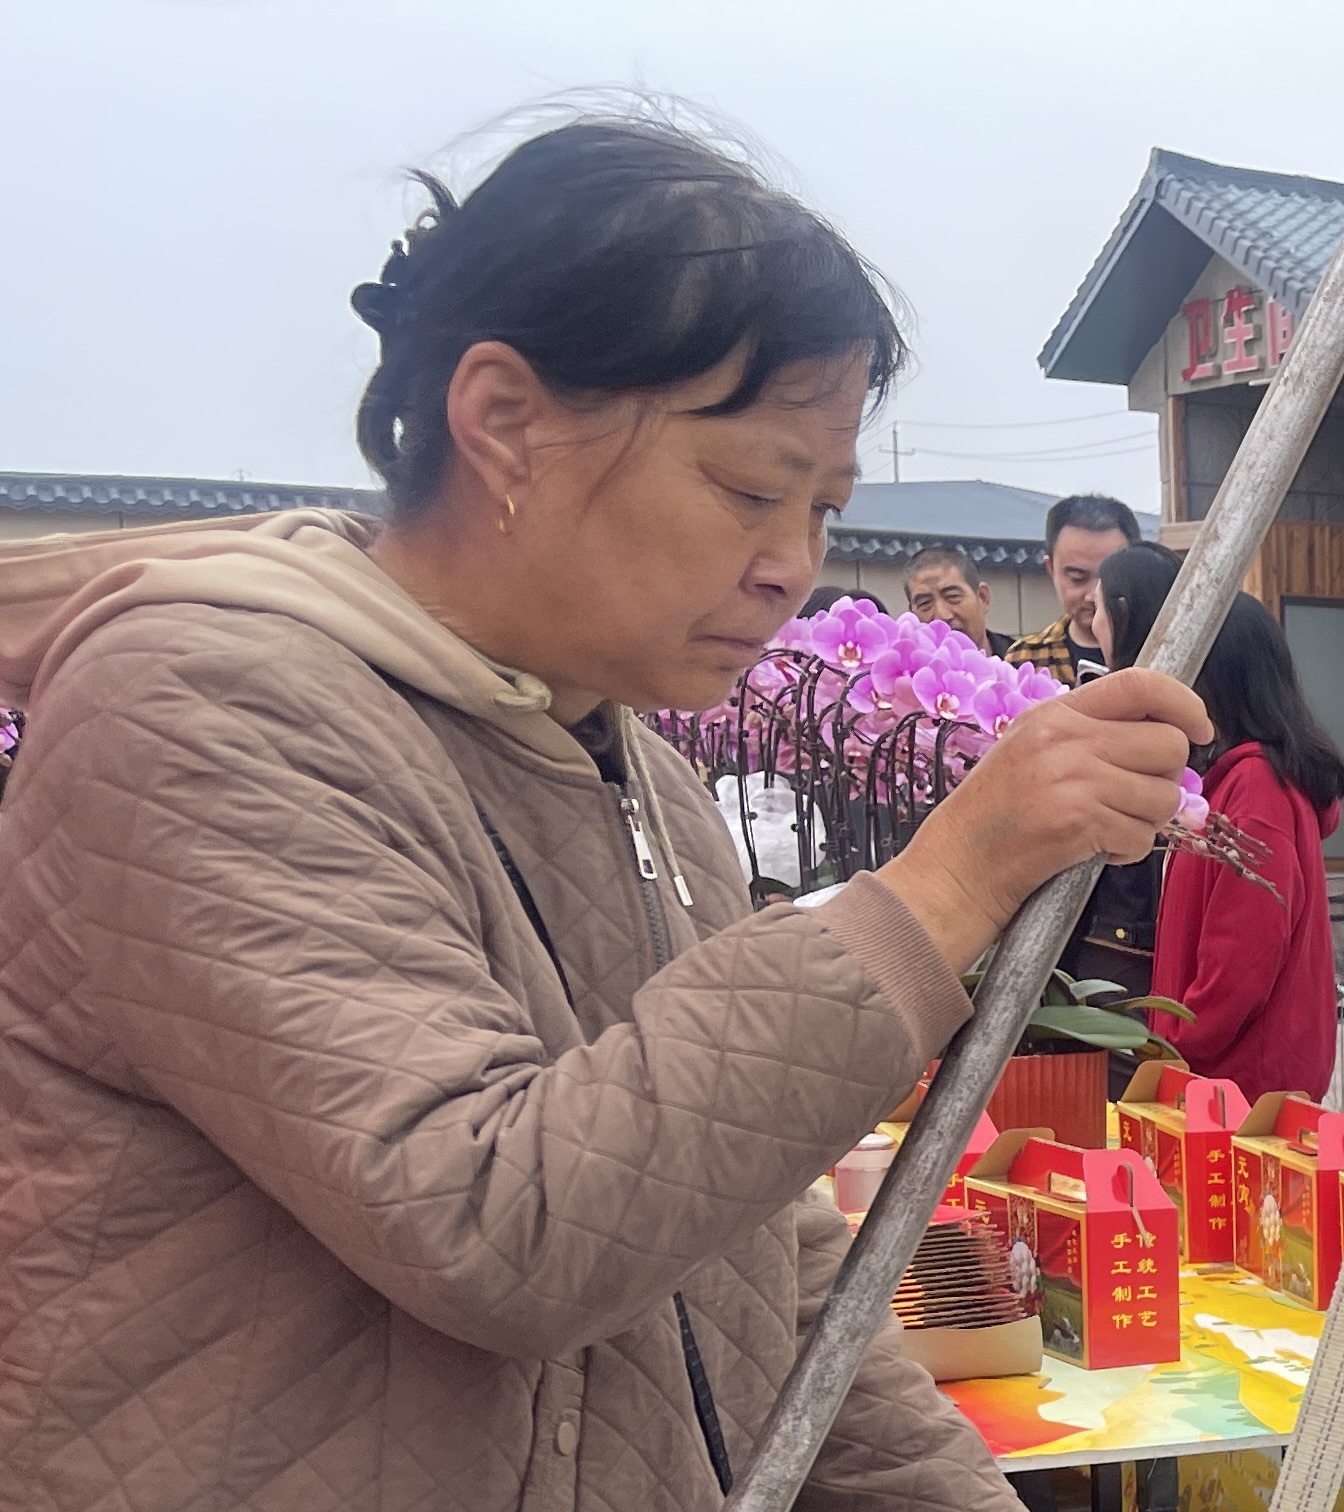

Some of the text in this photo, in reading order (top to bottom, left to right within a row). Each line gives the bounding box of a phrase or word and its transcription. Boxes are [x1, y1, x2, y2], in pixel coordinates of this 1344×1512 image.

[1207, 1148, 1226, 1230] 手工制作
[1111, 1232, 1133, 1329] 手工制作
[1136, 1232, 1158, 1328] 传统工艺
